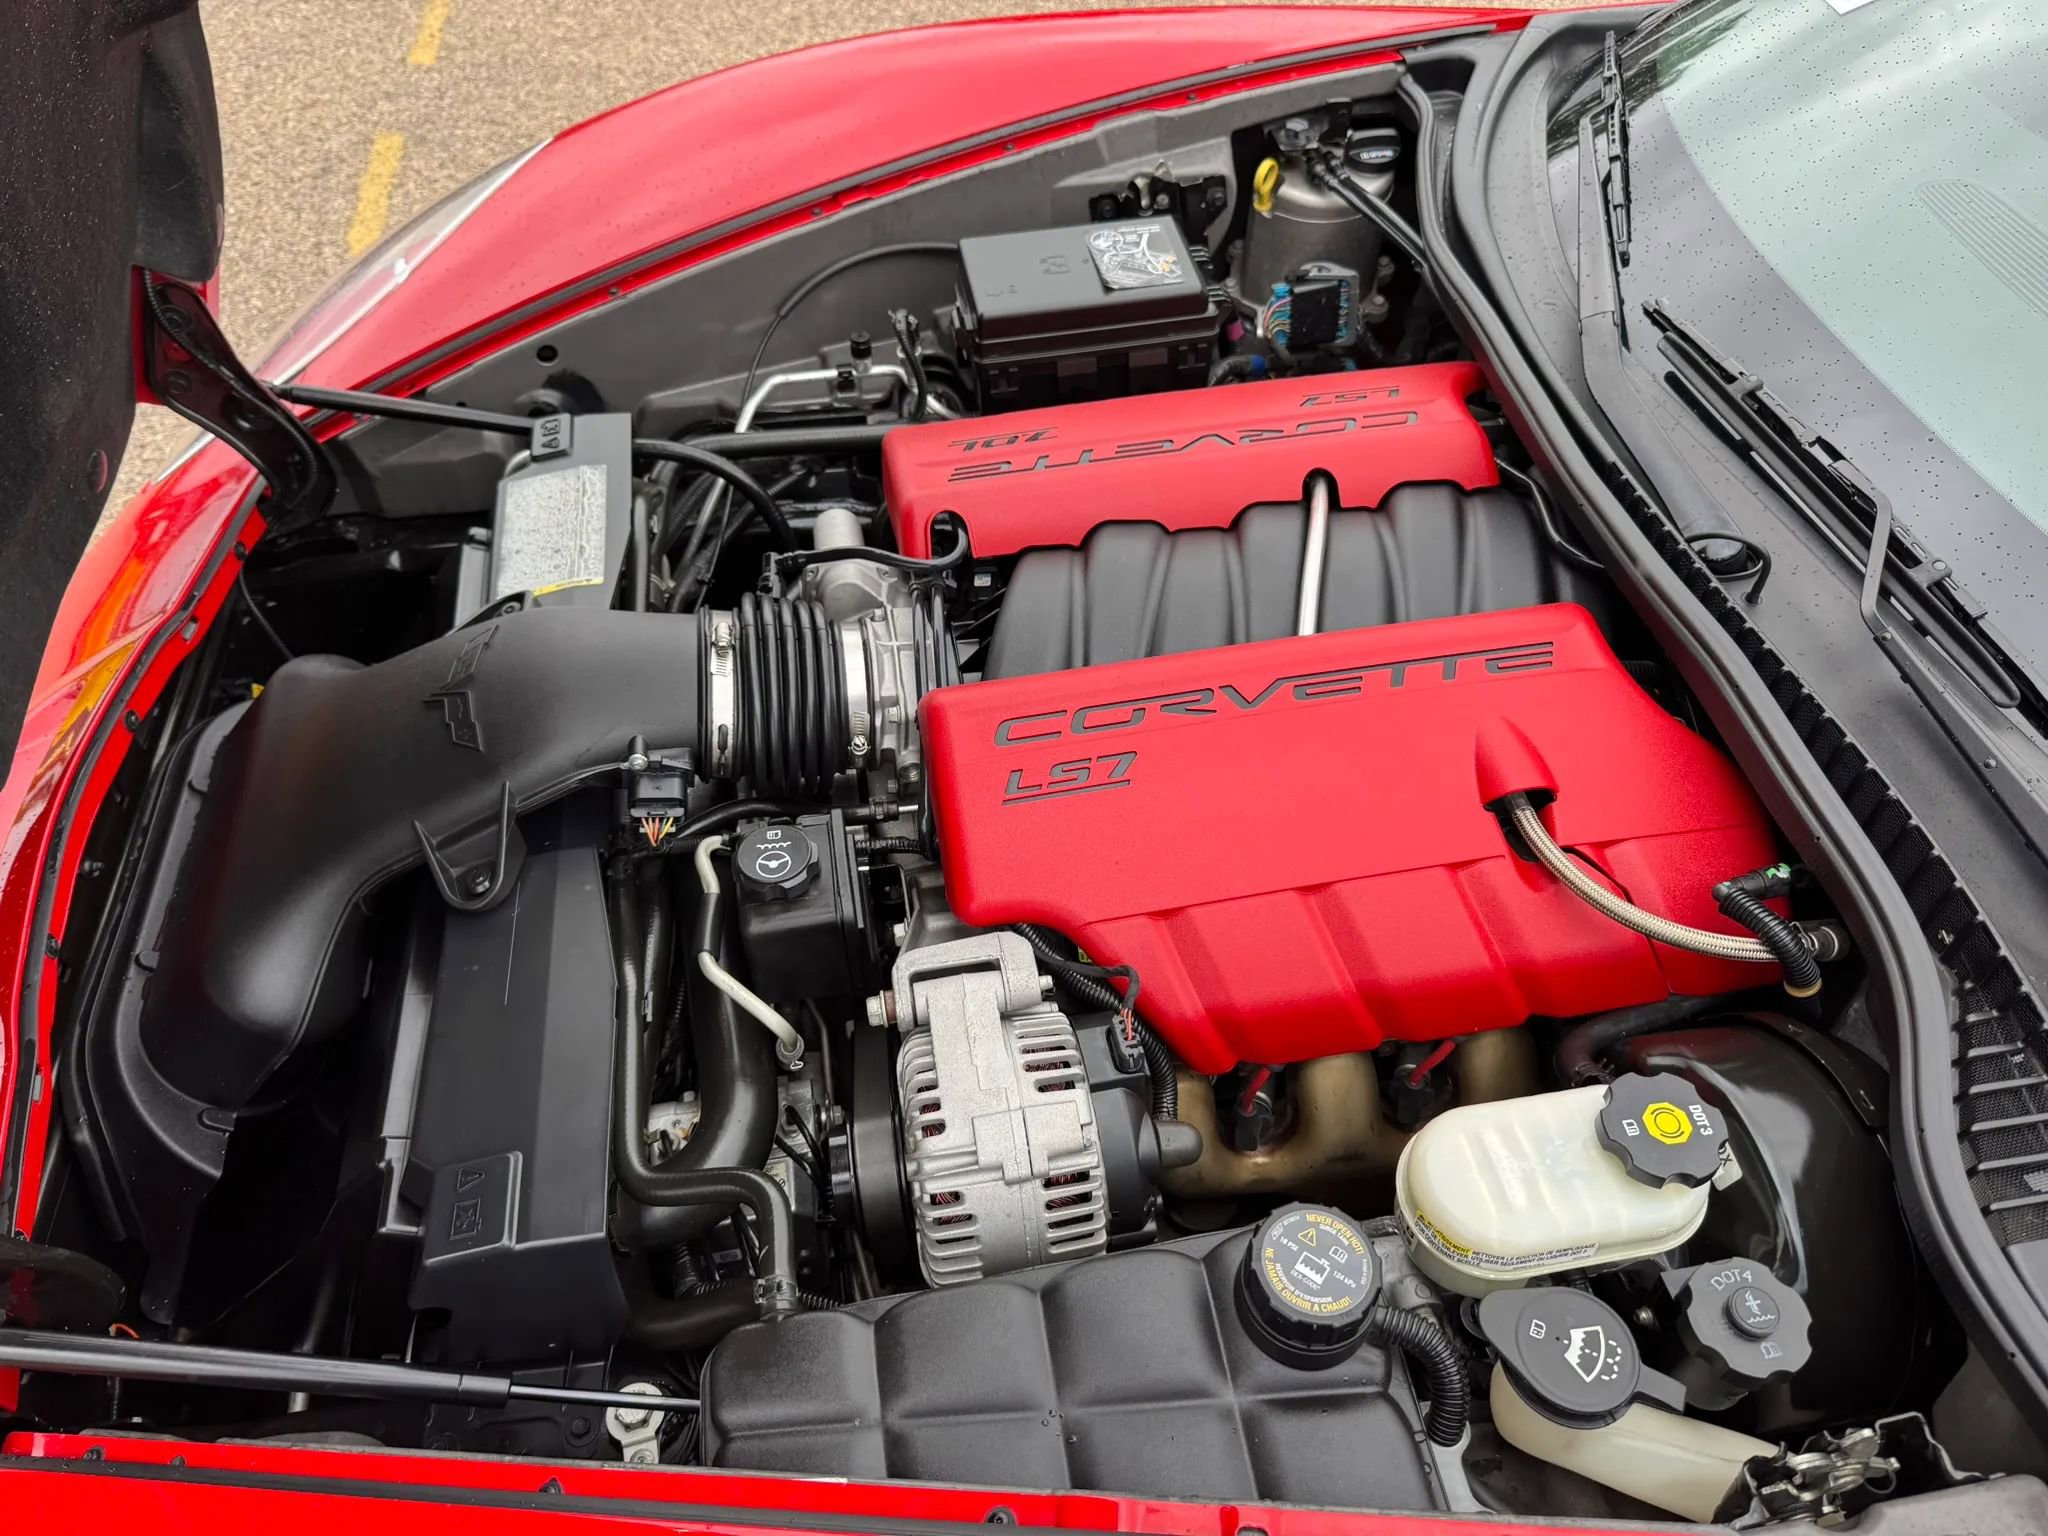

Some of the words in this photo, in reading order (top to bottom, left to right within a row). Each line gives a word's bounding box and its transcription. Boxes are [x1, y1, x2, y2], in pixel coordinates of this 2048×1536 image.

[948, 411, 1418, 482] CORVETTE
[994, 642, 1553, 747] CORVETTE
[1003, 751, 1138, 796] LS7
[1689, 1104, 1709, 1128] DOT
[1700, 1126, 1713, 1136] 3
[1306, 1213, 1332, 1225] NEVER
[1332, 1220, 1351, 1238] OPEN
[1265, 1247, 1274, 1260] NE
[1265, 1259, 1284, 1290] JAMAIS
[1281, 1289, 1311, 1310] OUVRIR
